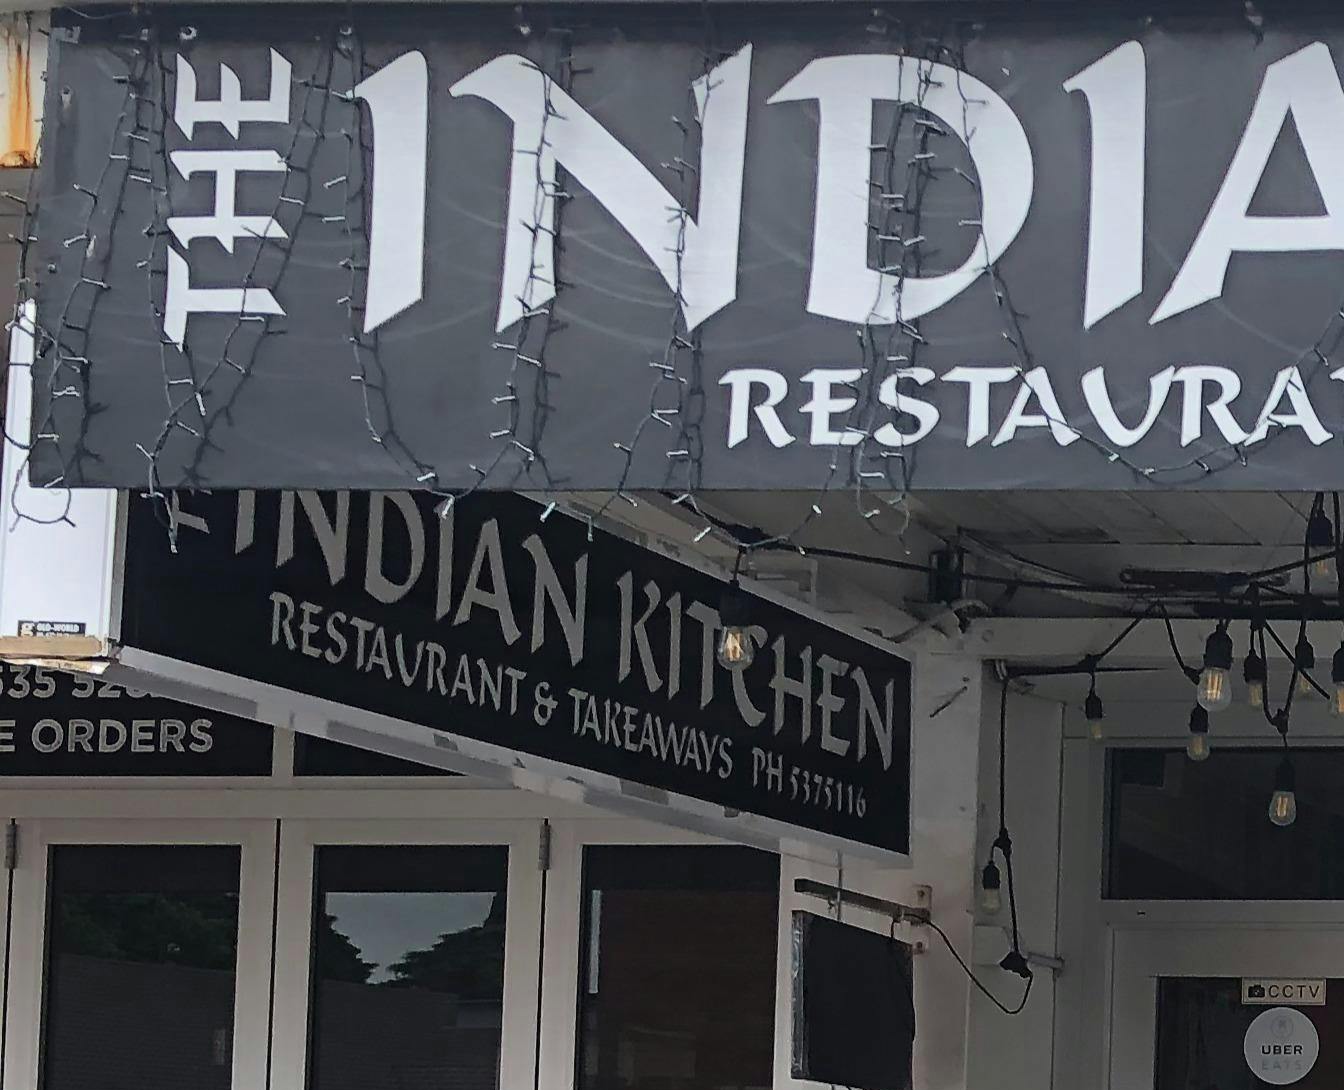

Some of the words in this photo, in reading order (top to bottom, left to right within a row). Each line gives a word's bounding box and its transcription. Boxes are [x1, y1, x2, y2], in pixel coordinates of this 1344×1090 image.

[160, 45, 293, 352] THE
[235, 488, 589, 668] INDIAN
[616, 569, 896, 772] KITCHEN
[31, 718, 214, 752] ORDERS
[269, 591, 527, 716] RESTAURANT
[534, 681, 558, 727] &
[567, 687, 733, 780] TAKEAWAYS
[752, 747, 783, 795] PH
[789, 765, 867, 819] 5375116
[1261, 1045, 1304, 1056] UBER
[1267, 984, 1321, 999] CCTV
